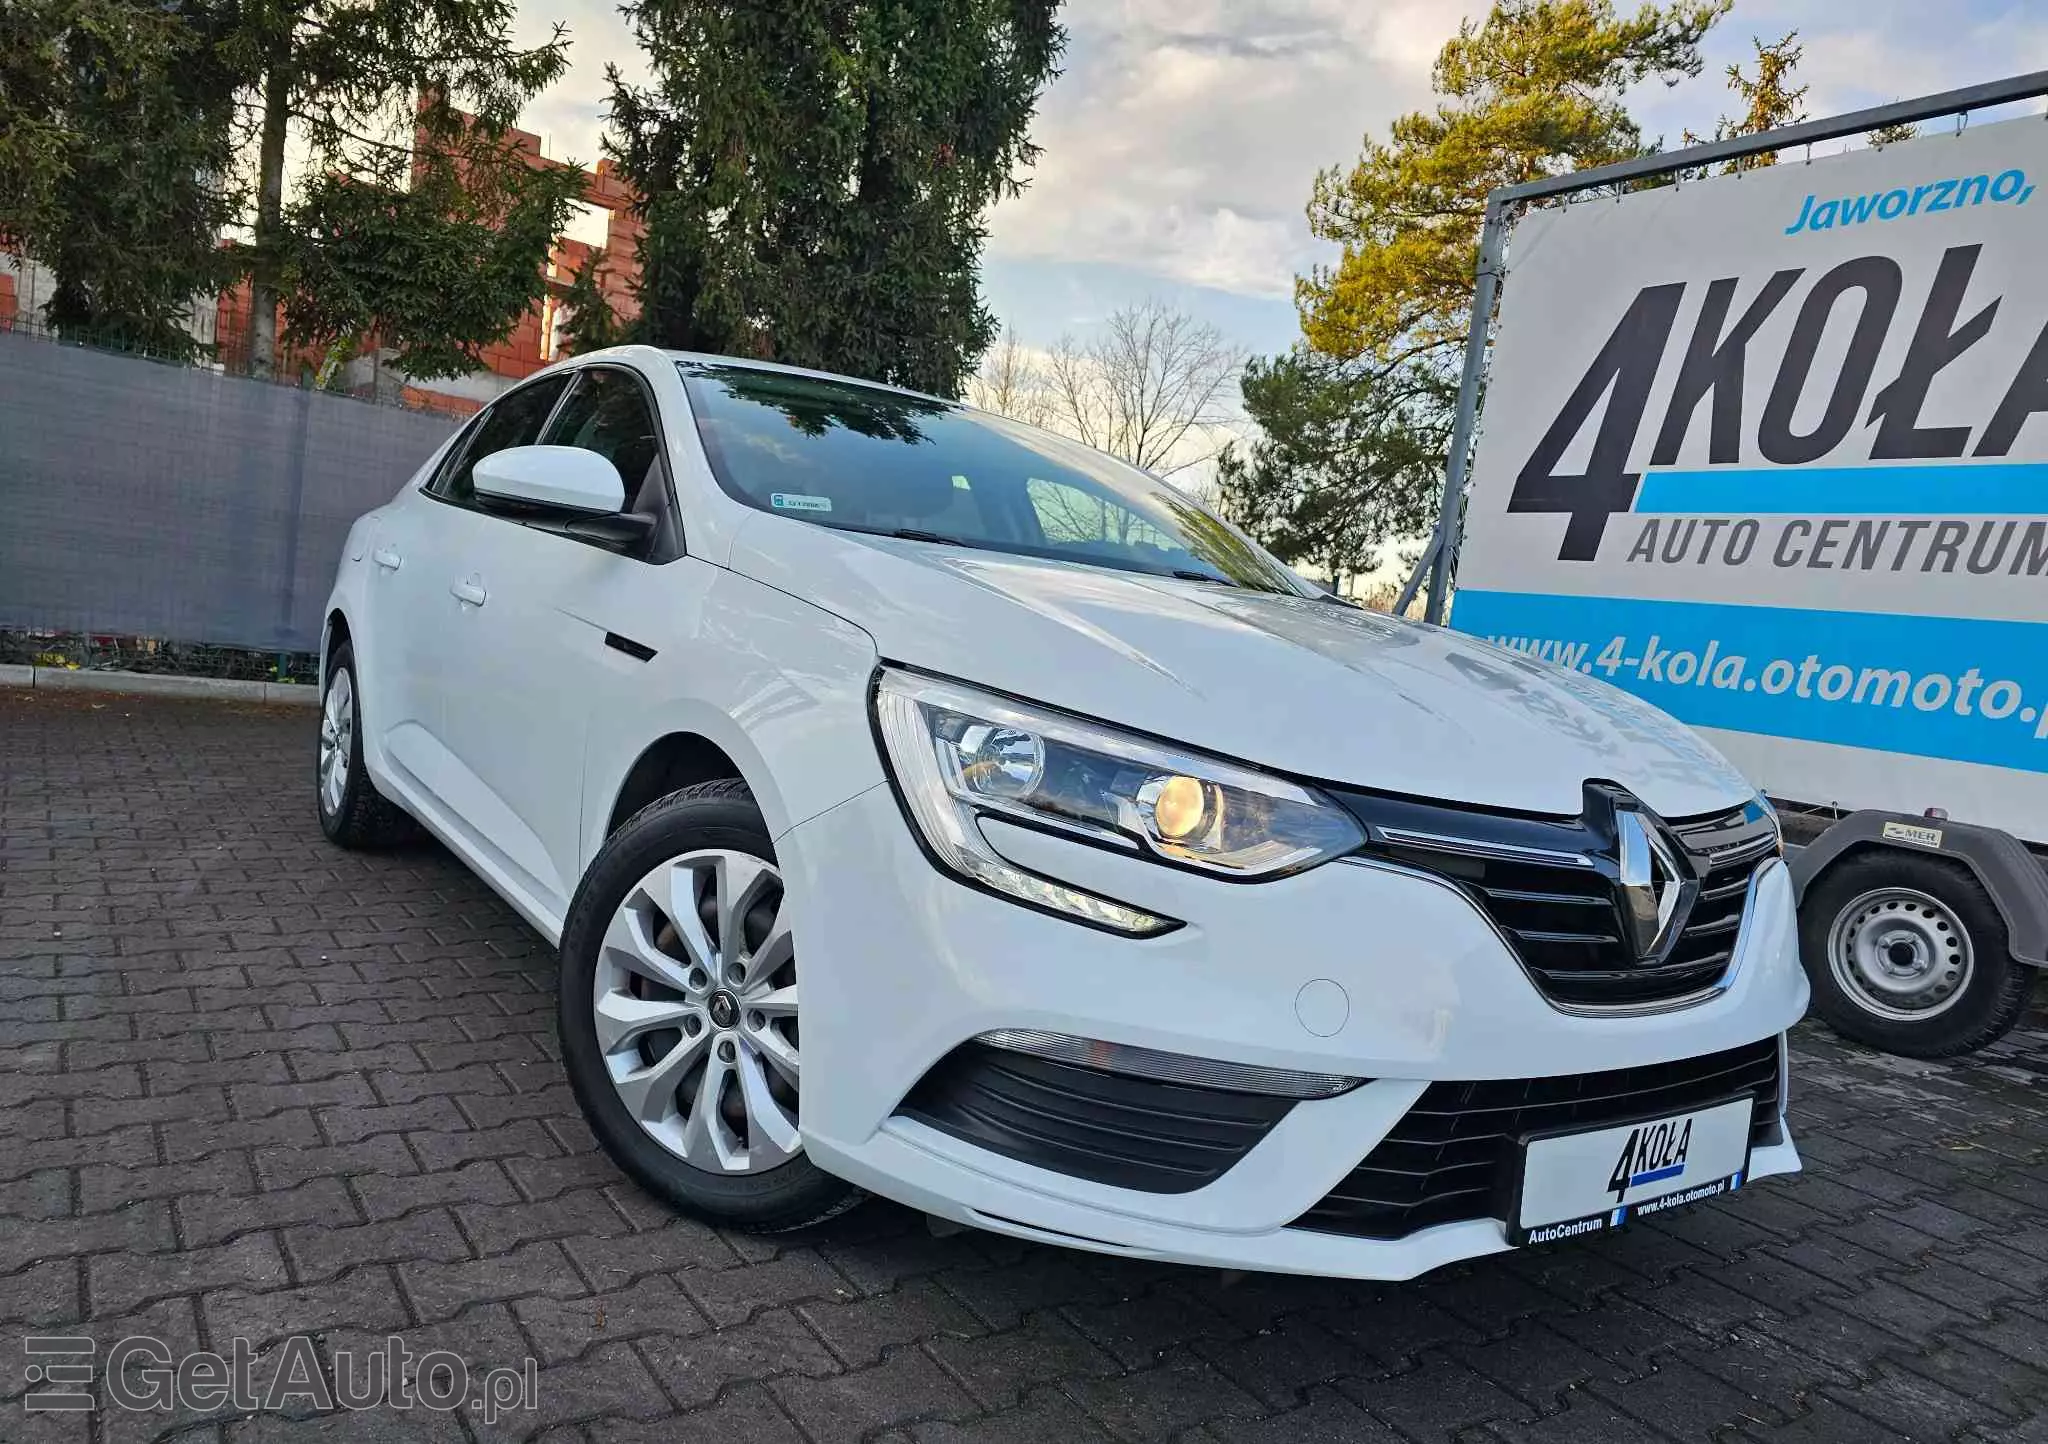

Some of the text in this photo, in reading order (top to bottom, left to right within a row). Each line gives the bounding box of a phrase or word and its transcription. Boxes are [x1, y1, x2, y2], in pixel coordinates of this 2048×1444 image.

[1785, 168, 2037, 235] Jaworzno,
[1627, 518, 1760, 566] AUTO
[1487, 634, 2048, 739] ww.4-kola.otomoto.
[1606, 1118, 1693, 1204] 4KOŁA
[1528, 1179, 1725, 1245] AutoCentrum www.4-kola.otomoto.pl
